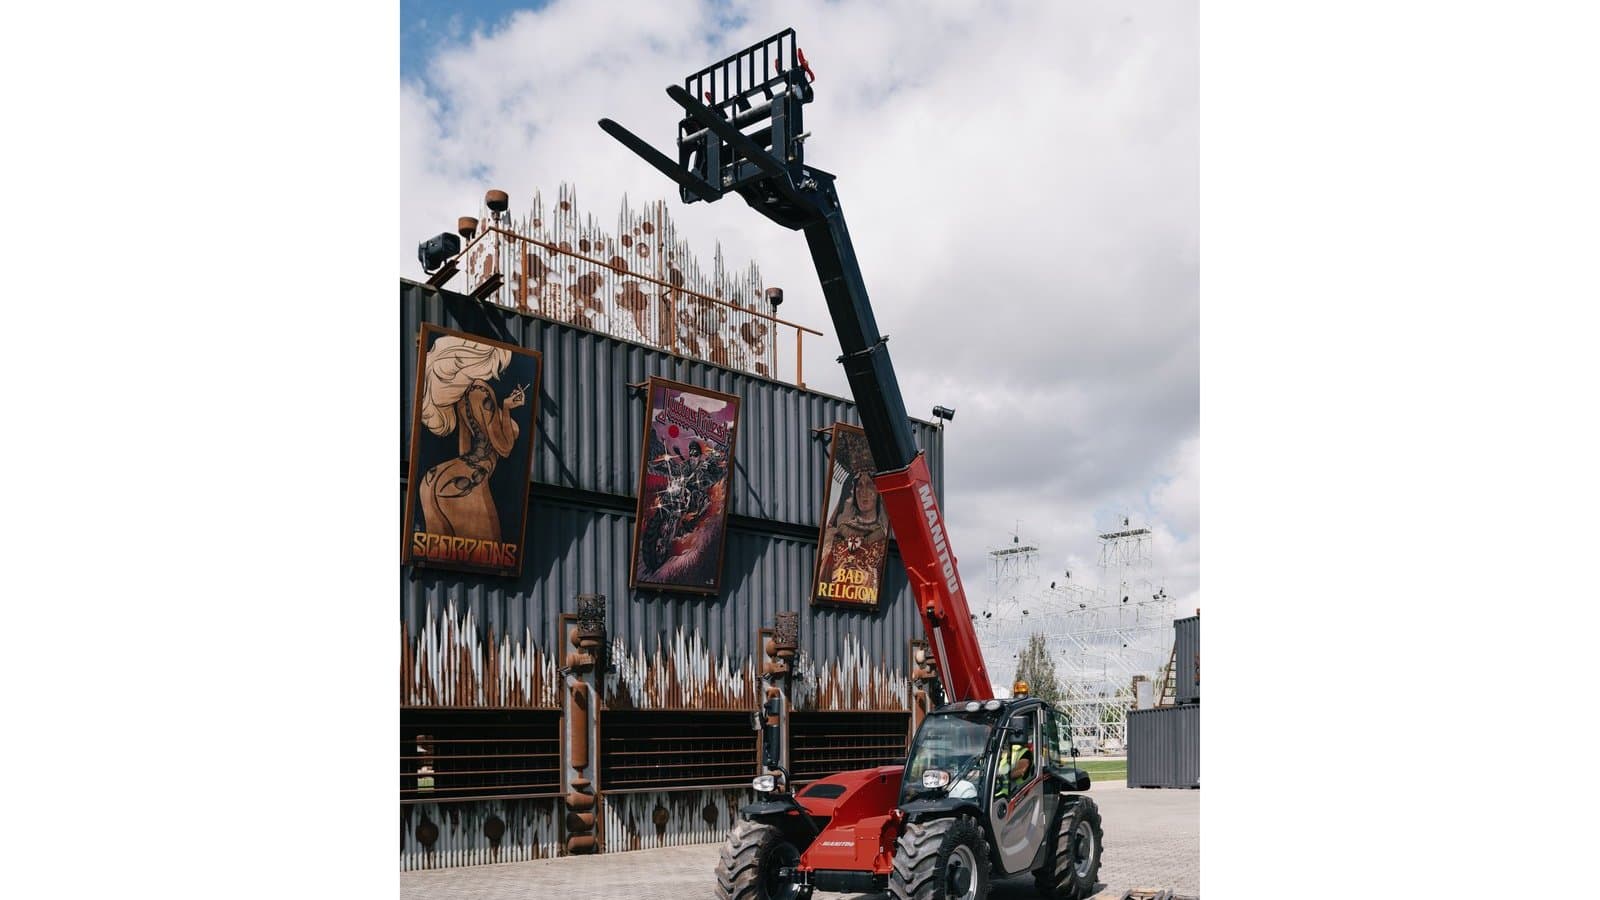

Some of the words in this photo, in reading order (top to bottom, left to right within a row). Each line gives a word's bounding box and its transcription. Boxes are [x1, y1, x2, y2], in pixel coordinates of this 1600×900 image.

[413, 531, 518, 567] SCORPIONS
[918, 483, 960, 595] MANITOU
[837, 567, 866, 585] BAD
[818, 581, 878, 605] RELIGION
